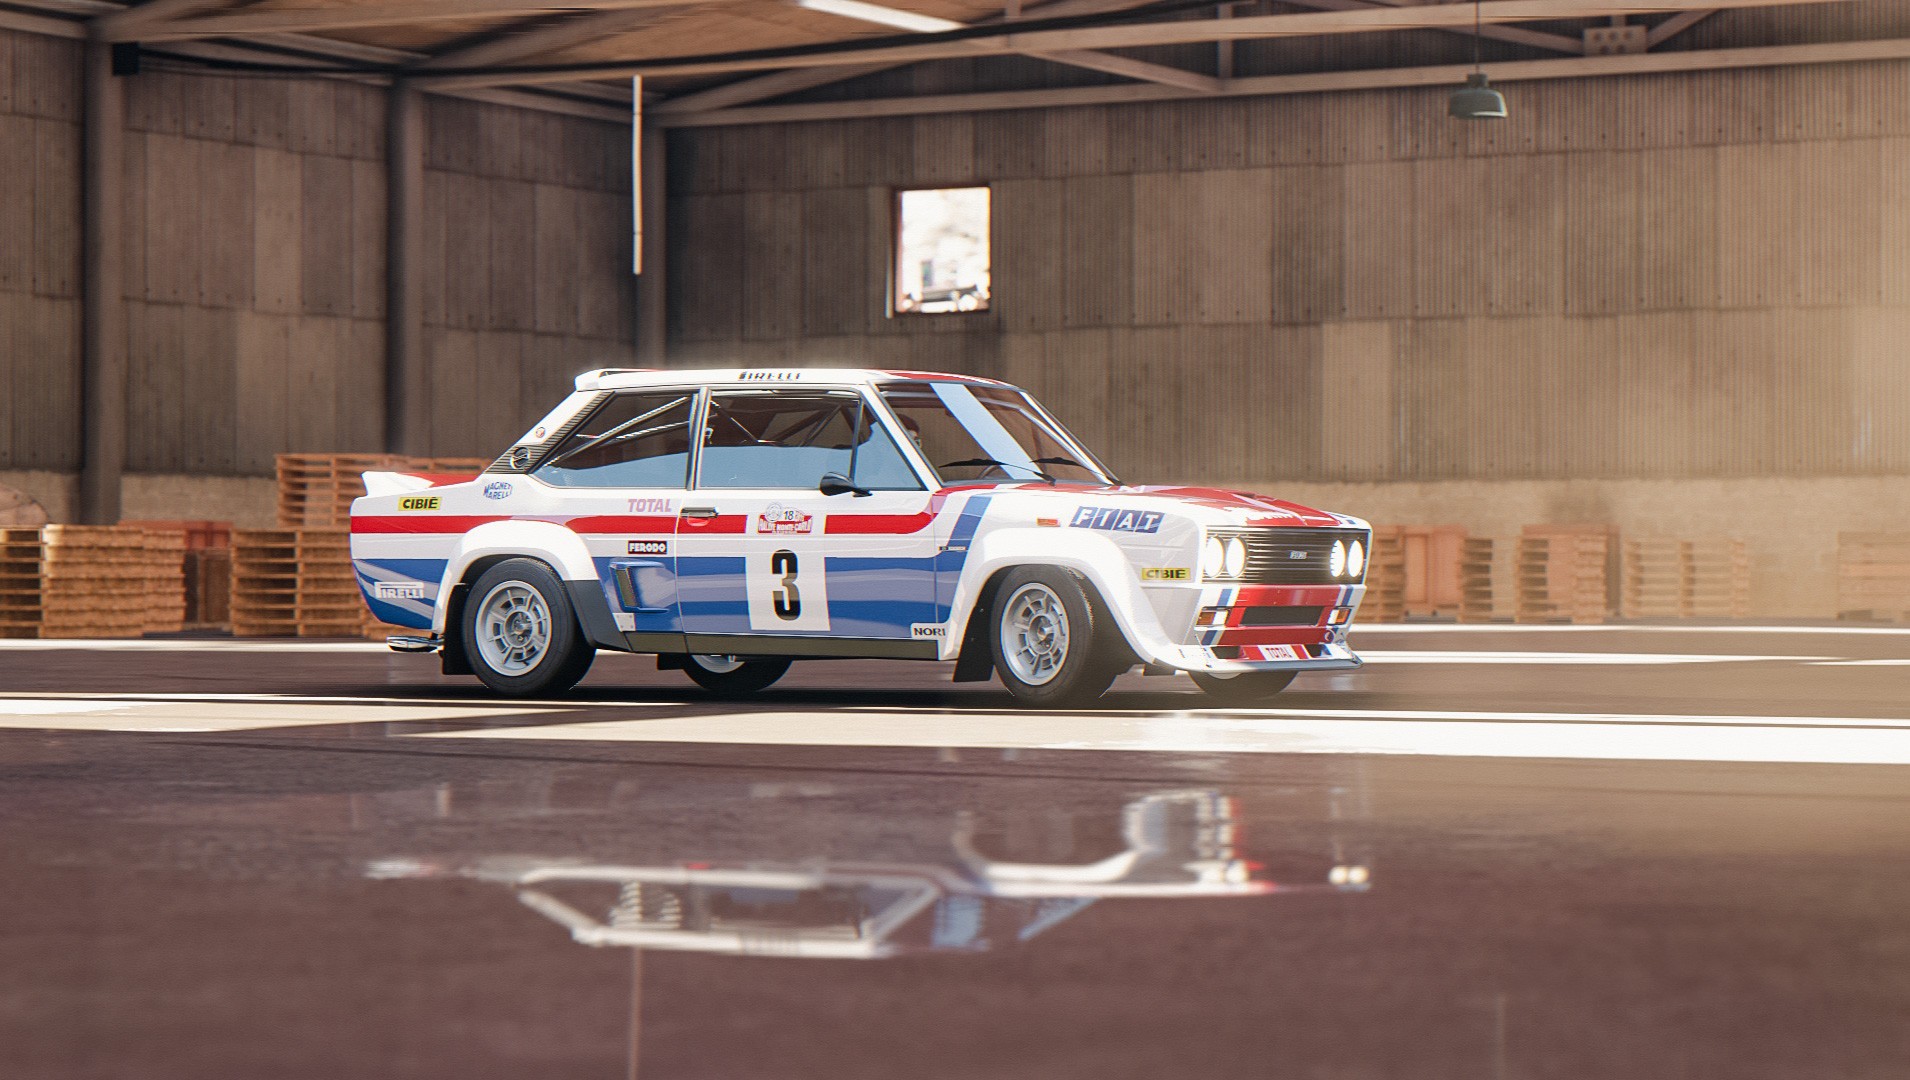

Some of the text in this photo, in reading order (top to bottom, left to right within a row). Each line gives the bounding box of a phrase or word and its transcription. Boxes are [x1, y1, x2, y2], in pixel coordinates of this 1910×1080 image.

[628, 499, 672, 512] TOTAL
[783, 510, 794, 520] 18
[1073, 507, 1161, 531] FIAT
[629, 543, 667, 553] FERODO
[374, 582, 424, 599] PIRELLI
[771, 549, 801, 621] 3
[1265, 647, 1293, 659] TOTAL
